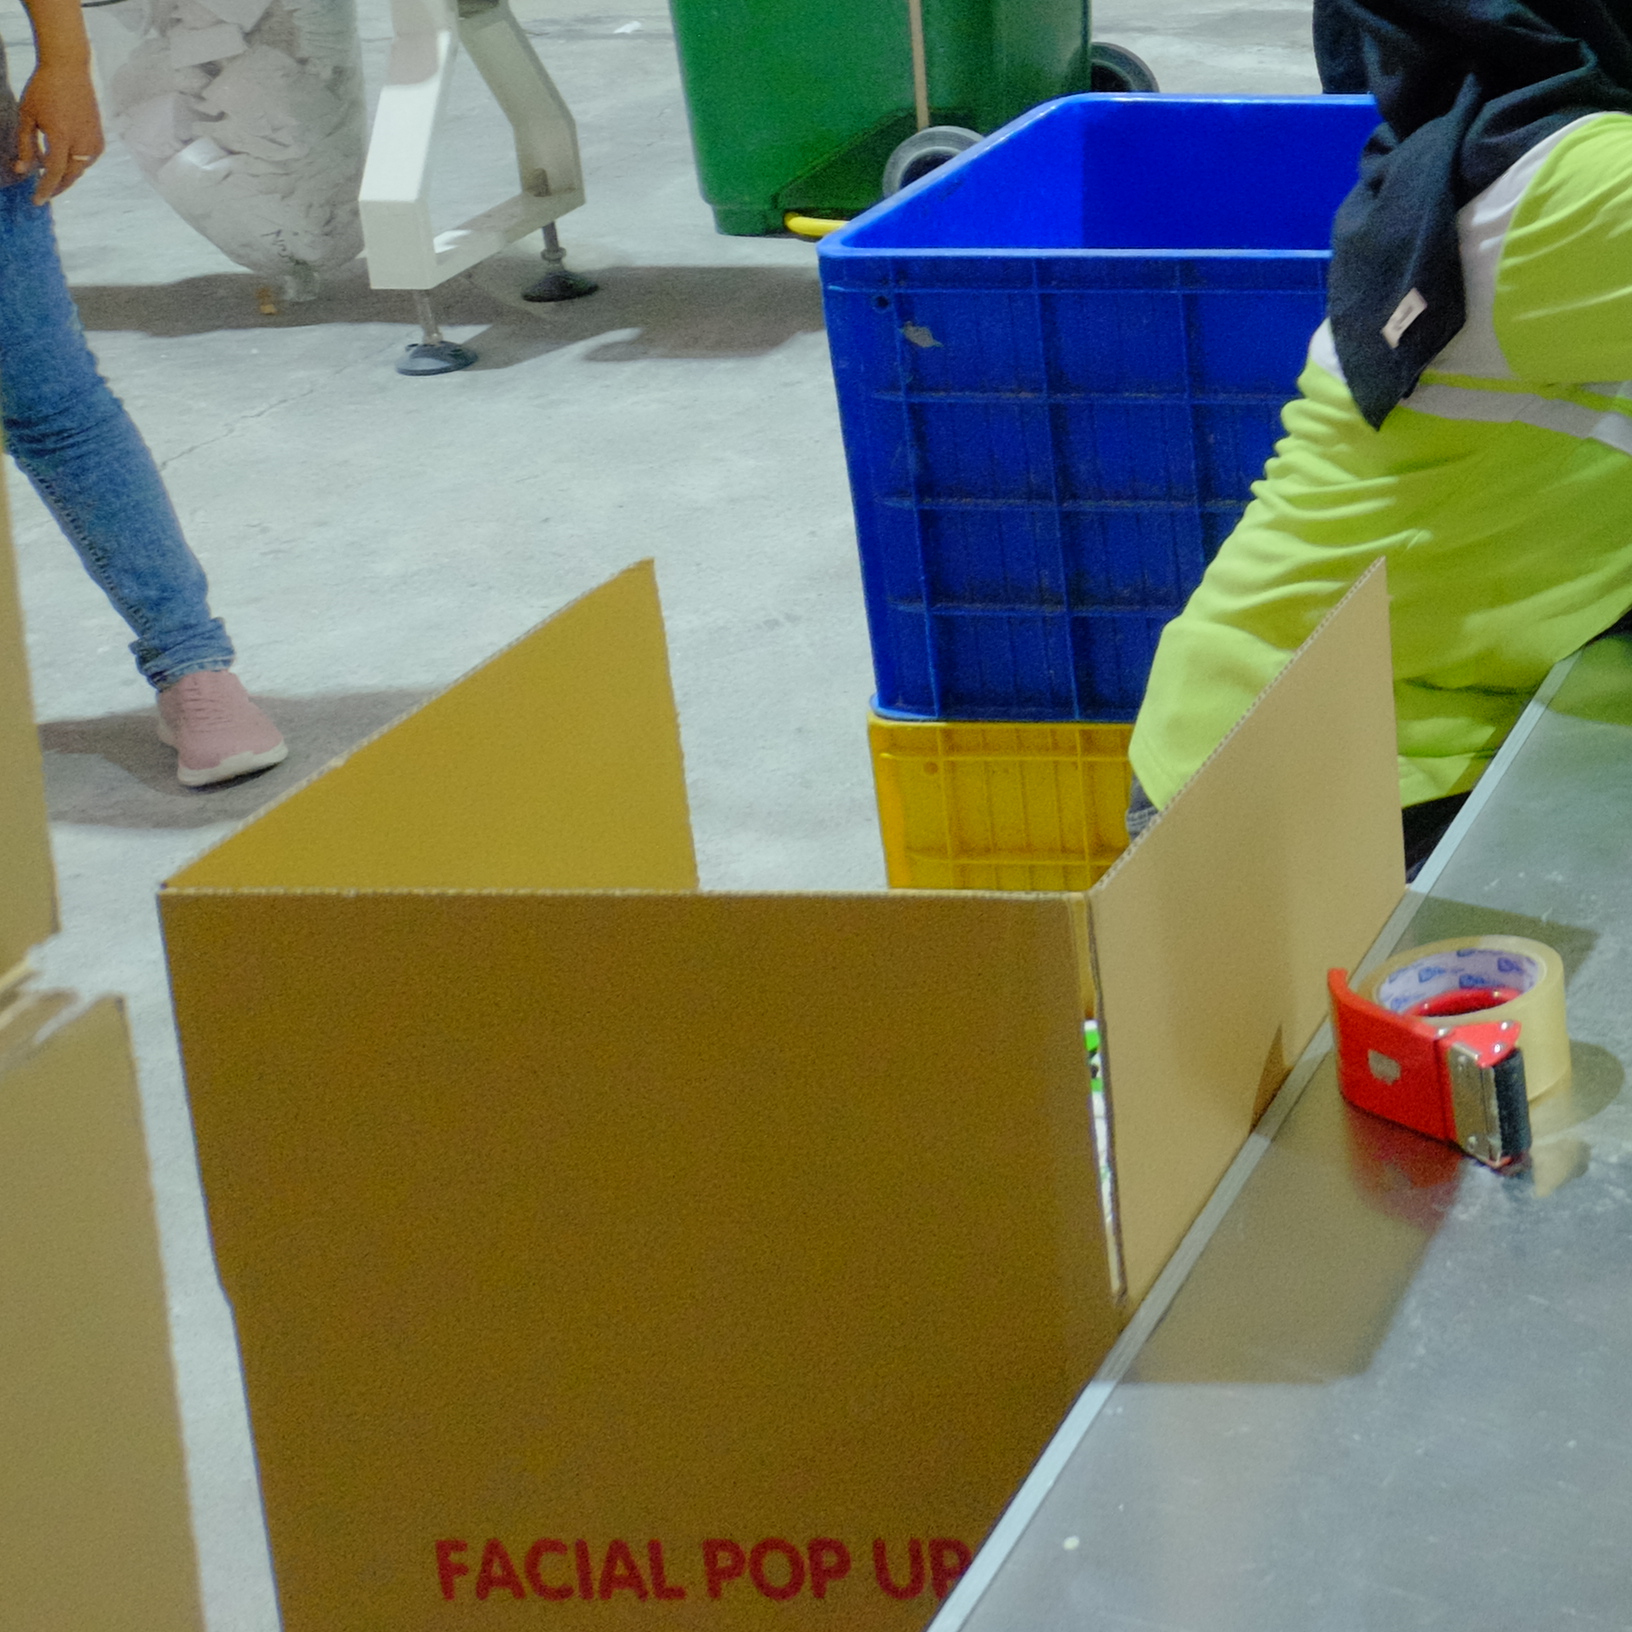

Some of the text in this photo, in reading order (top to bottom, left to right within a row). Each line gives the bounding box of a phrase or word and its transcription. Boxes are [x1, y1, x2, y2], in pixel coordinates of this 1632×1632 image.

[434, 1537, 975, 1602] FACIAL POP UP
